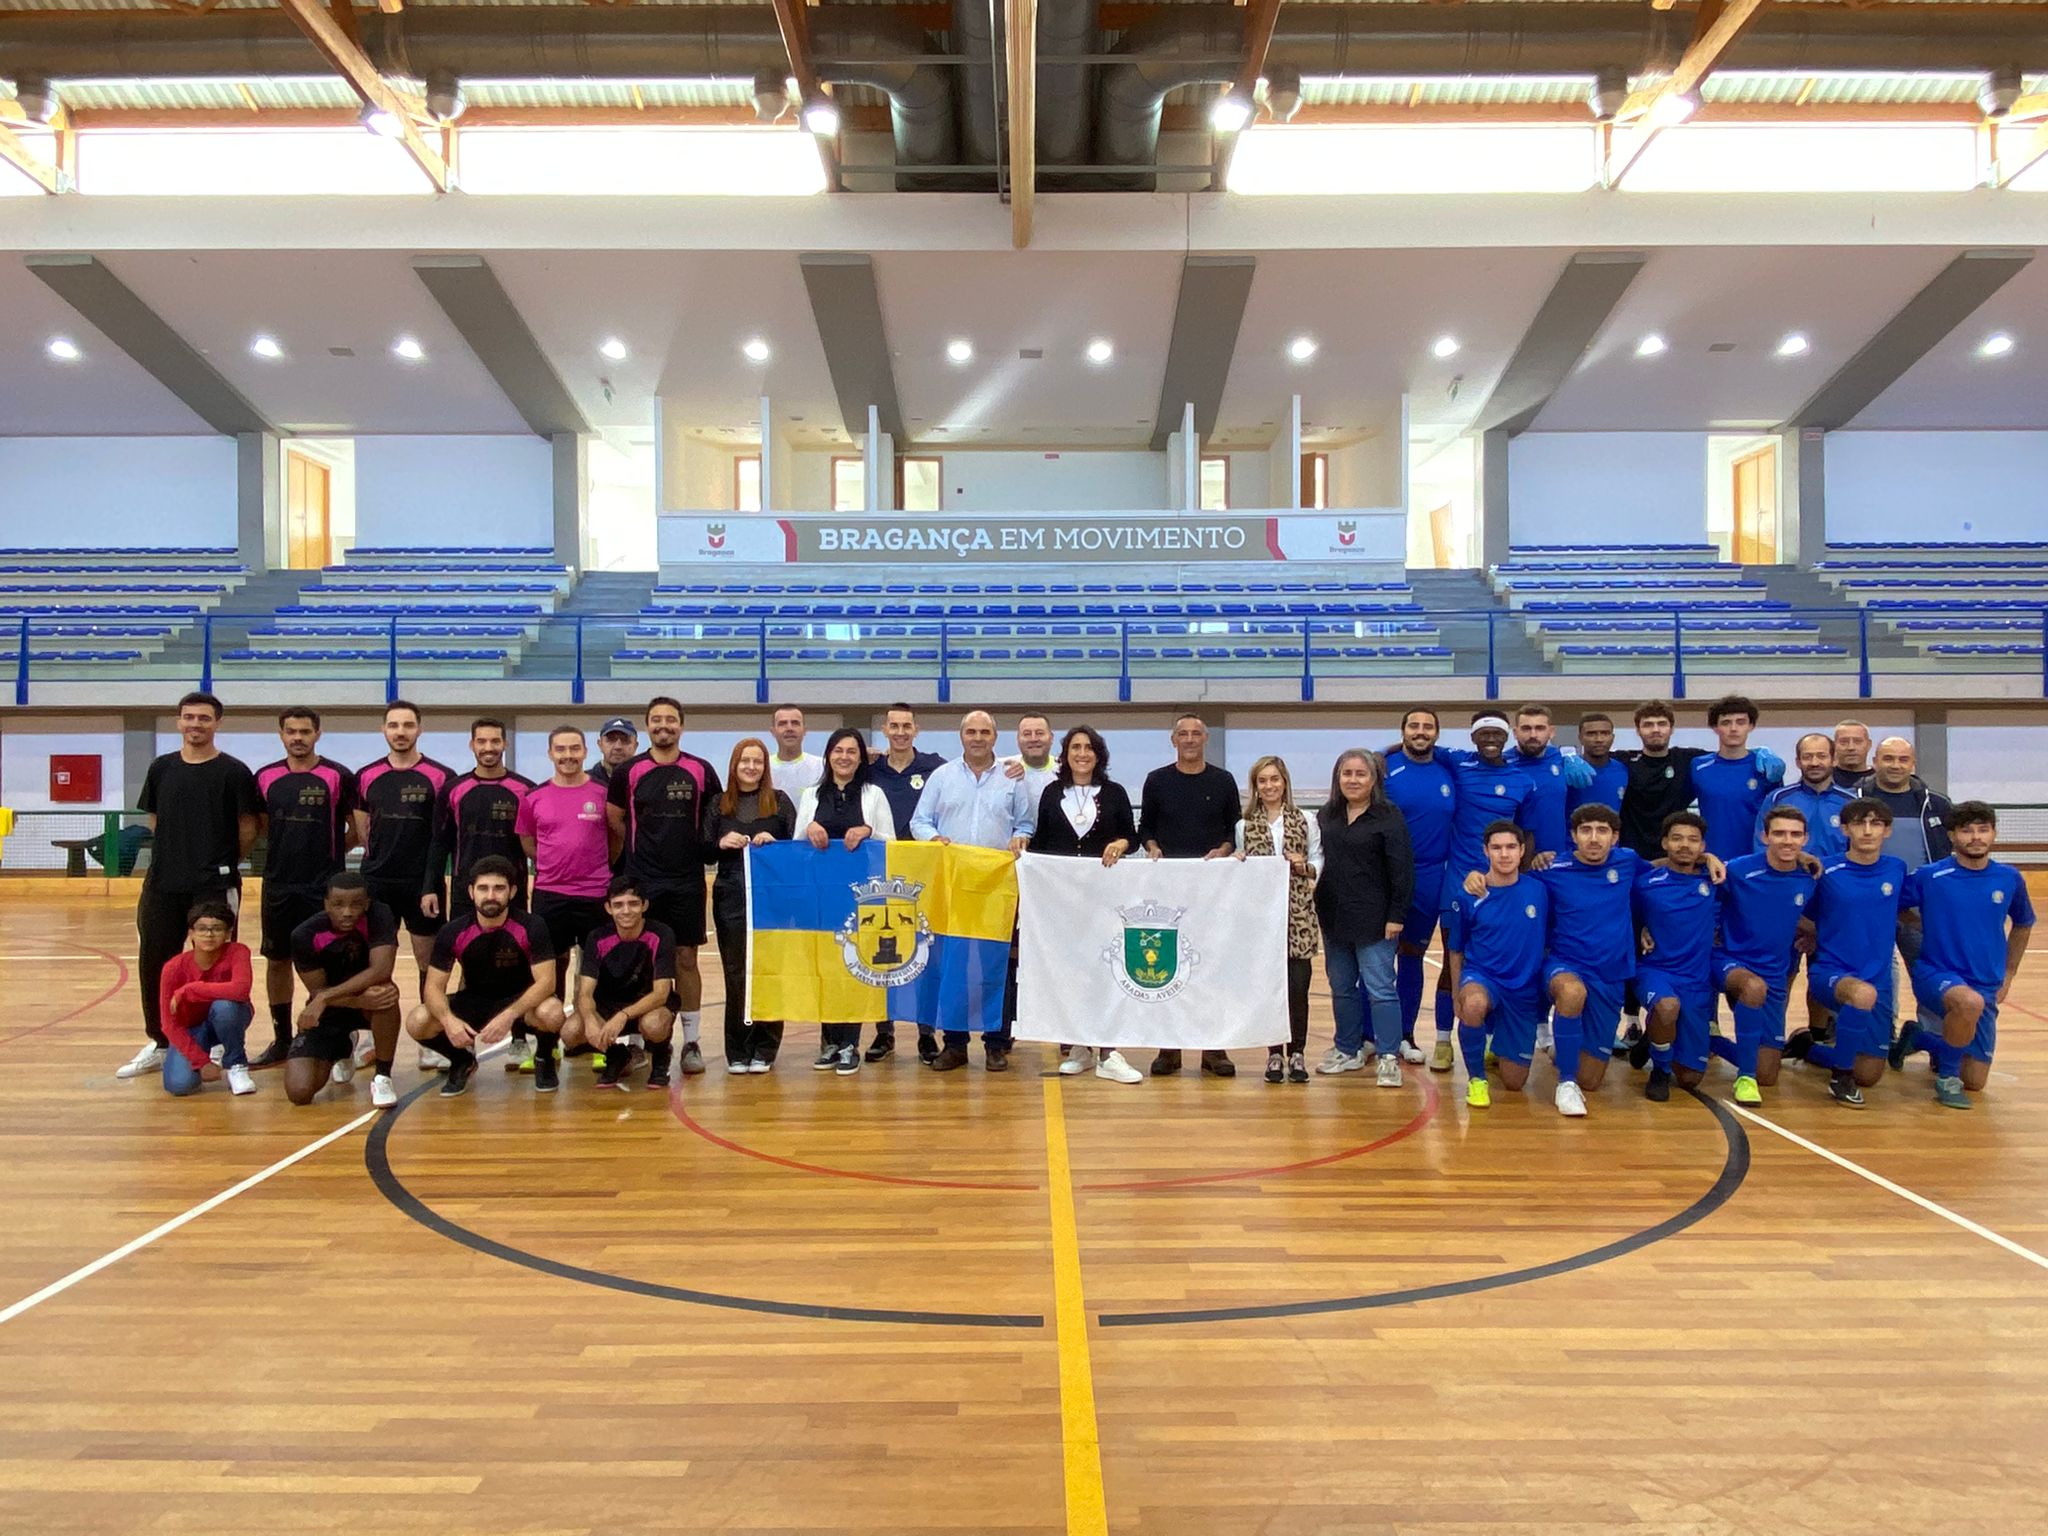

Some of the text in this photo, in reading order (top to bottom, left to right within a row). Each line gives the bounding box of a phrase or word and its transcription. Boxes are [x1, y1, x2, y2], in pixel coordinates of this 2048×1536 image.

[819, 526, 1246, 557] BRAGANÇA EM MOVIMENTO
[1120, 979, 1150, 1000] ARADAS
